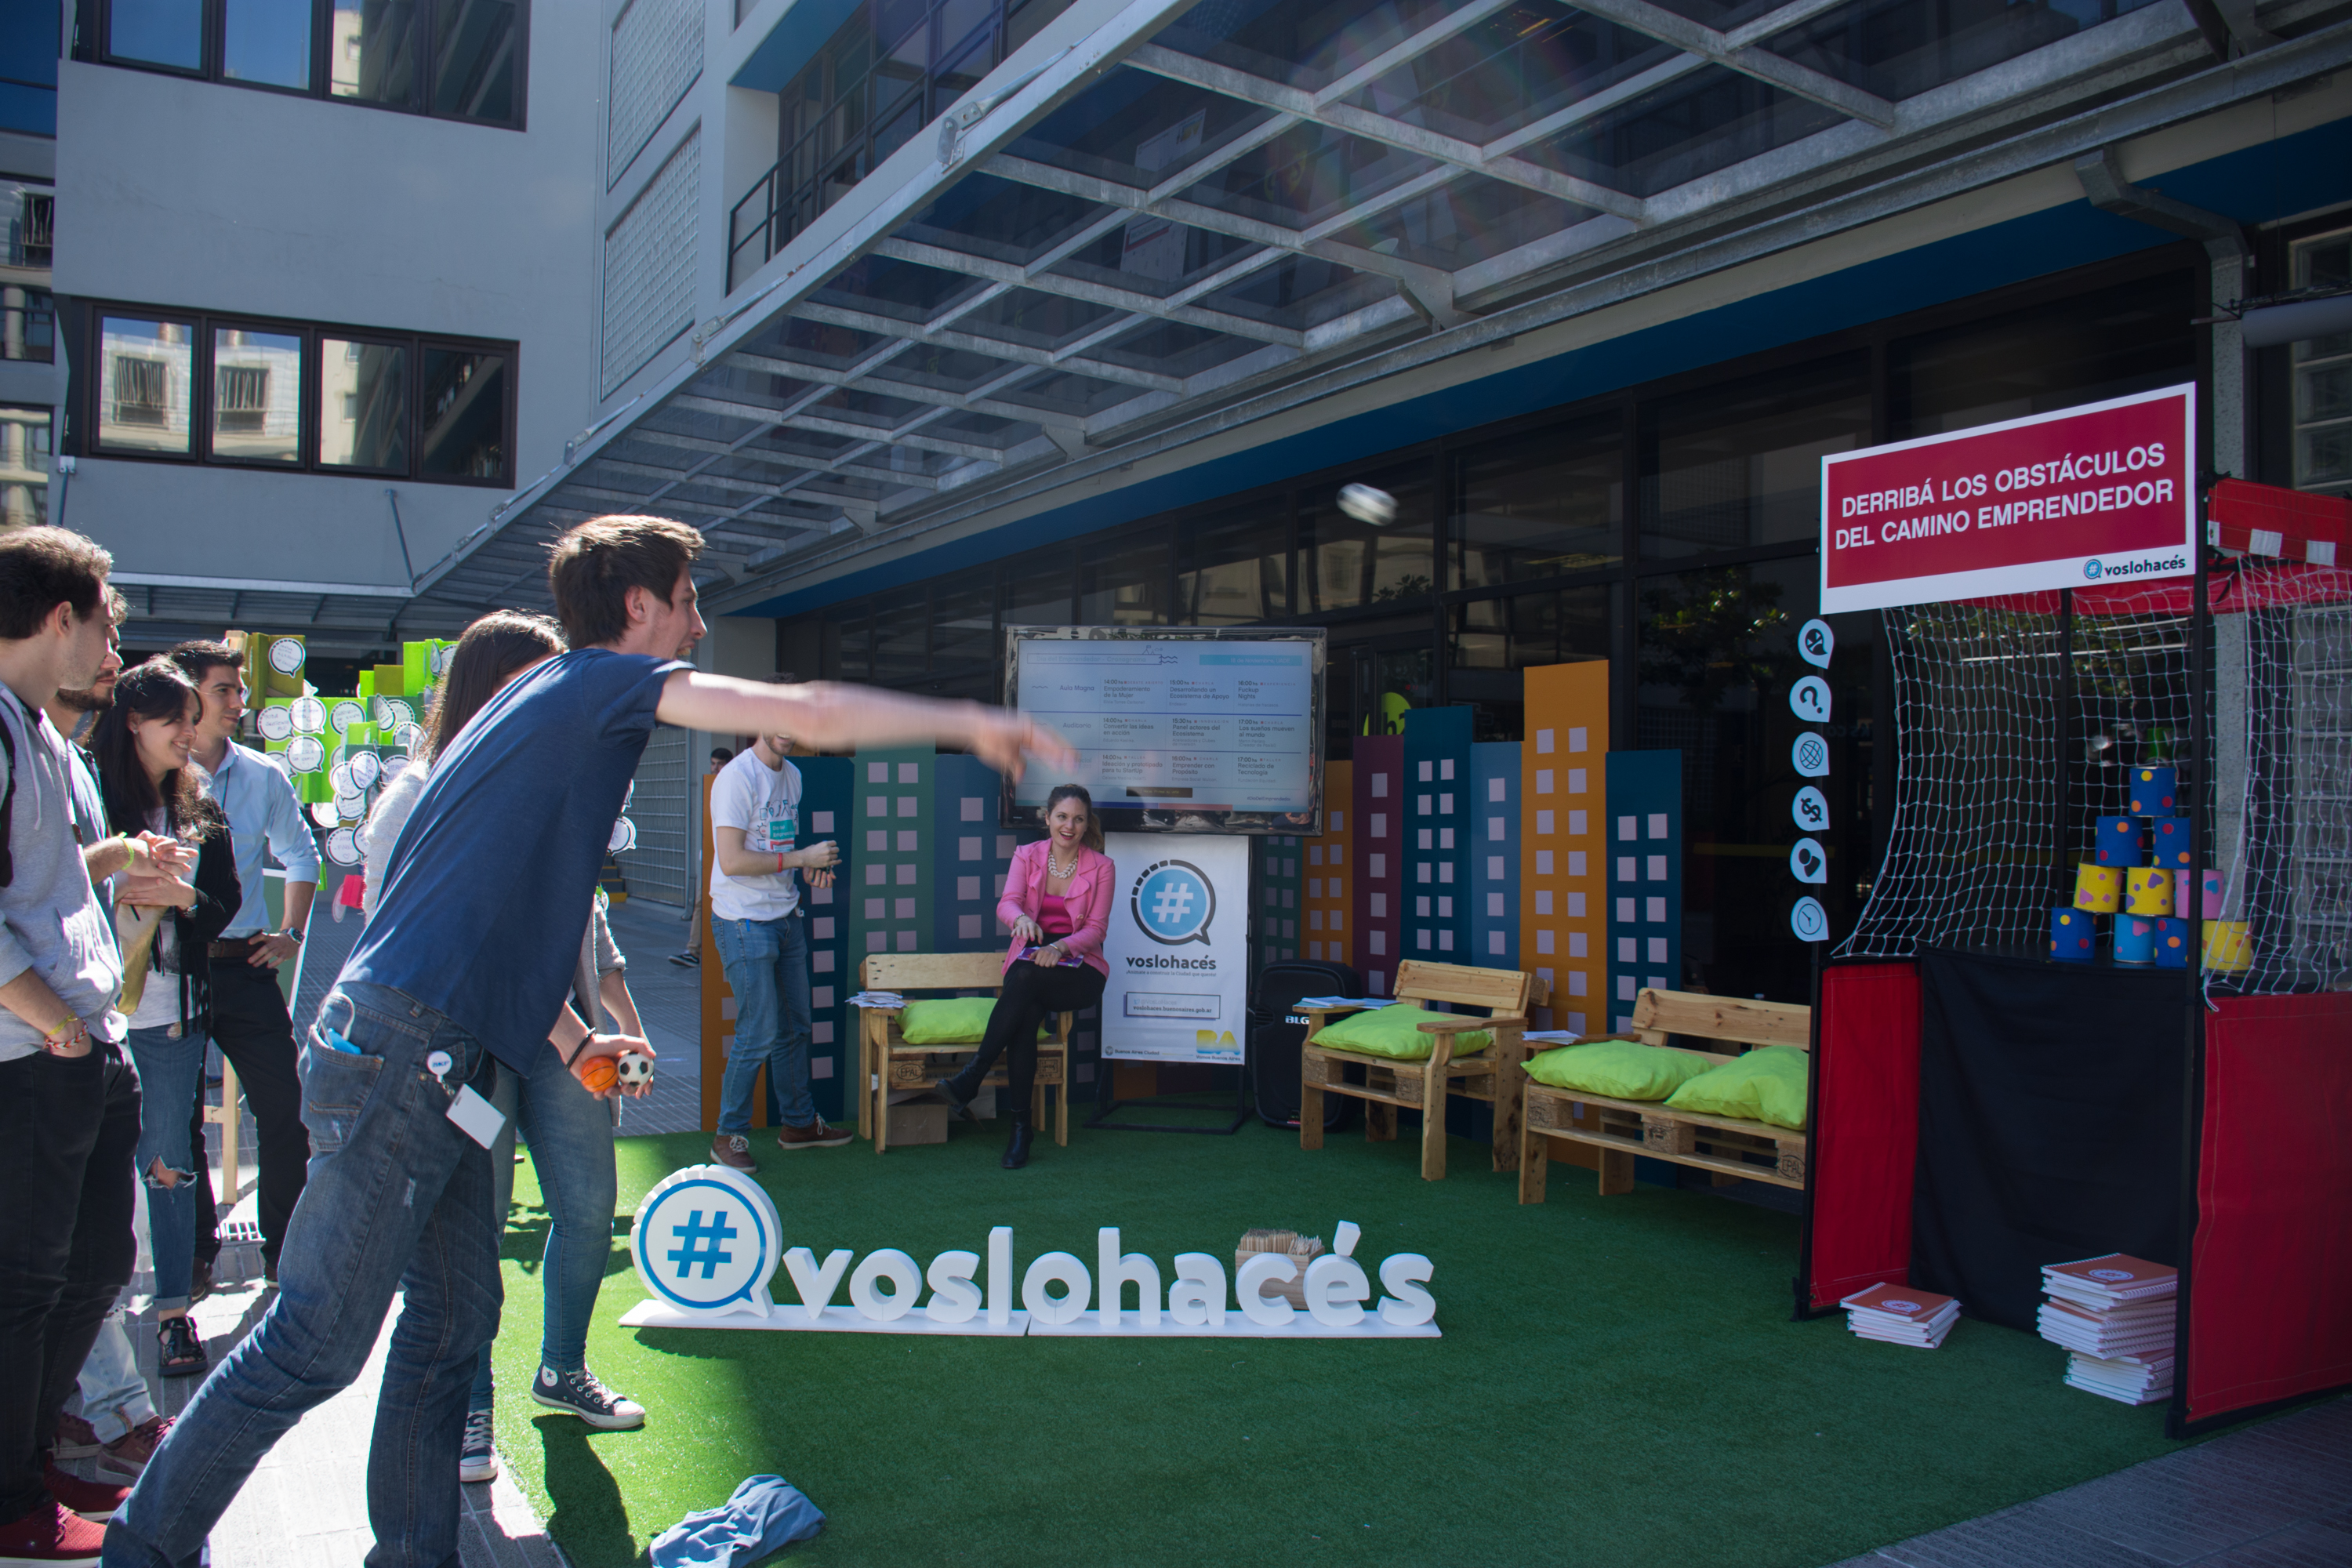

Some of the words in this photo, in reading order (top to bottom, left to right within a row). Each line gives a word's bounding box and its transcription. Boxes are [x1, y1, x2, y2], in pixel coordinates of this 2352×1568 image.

[1842, 477, 1935, 517] DERRIBÁ
[1942, 474, 1987, 502] LOS
[1994, 442, 2165, 493] OBSTÁCULOS
[1835, 524, 1875, 550] DEL
[1881, 510, 1970, 543] CAMINO
[1978, 478, 2174, 529] EMPRENDEDOR
[2104, 554, 2187, 576] voslohacés
[1126, 953, 1217, 970] voslohacés
[1133, 1005, 1212, 1014] voslohaces.buenosaires.gob.ar
[900, 1068, 919, 1077] EPAL
[782, 1220, 1437, 1327] voslohacés
